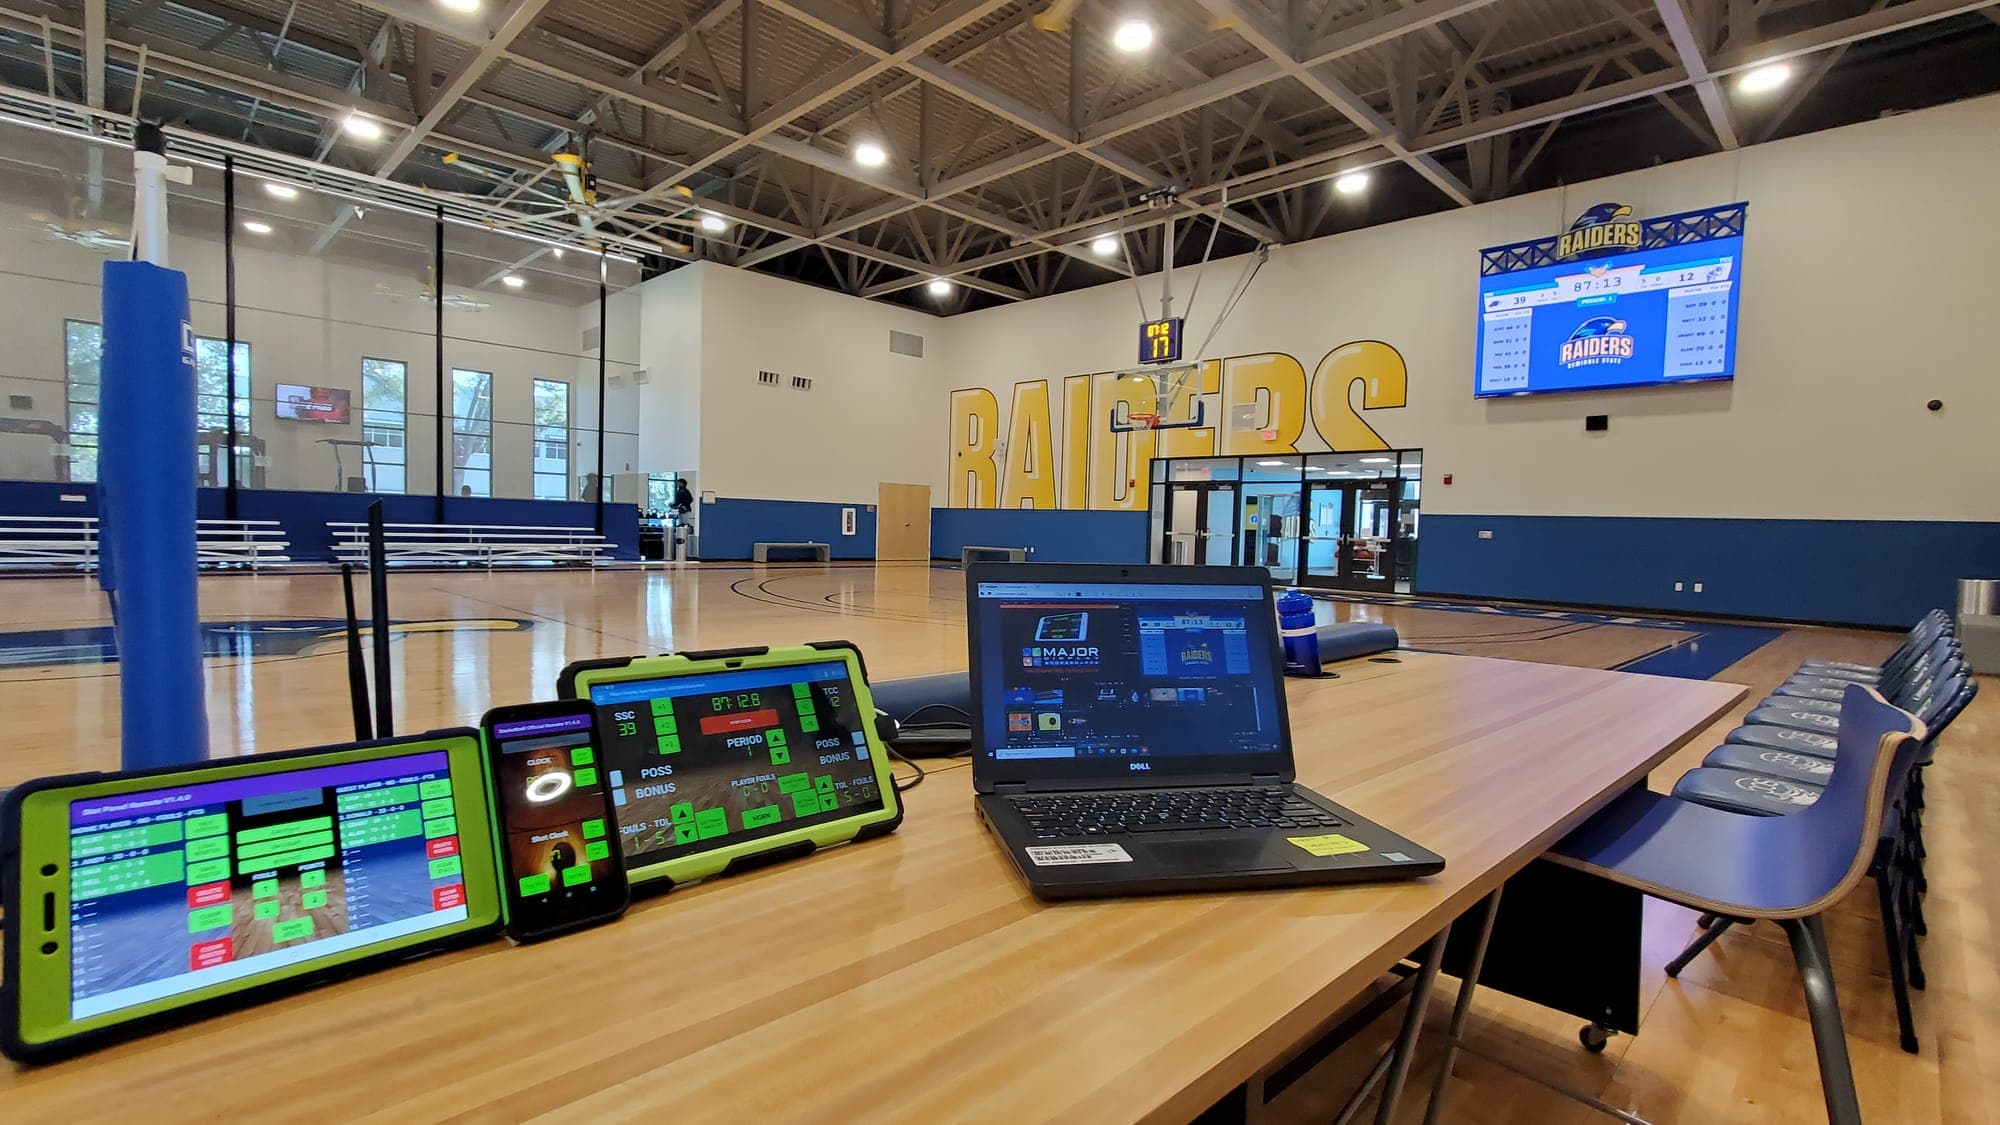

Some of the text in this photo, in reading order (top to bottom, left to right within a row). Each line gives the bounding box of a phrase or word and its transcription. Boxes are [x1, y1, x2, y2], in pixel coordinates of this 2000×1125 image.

[1559, 223, 1640, 257] RAIDERS
[1679, 272, 1694, 281] 12
[1574, 276, 1622, 292] 87:13
[1513, 296, 1526, 305] 39
[1153, 336, 1169, 358] 17
[1562, 336, 1631, 363] RAIDERS
[947, 340, 1408, 511] RAIDERS
[1043, 647, 1099, 657] MAJOR
[1181, 649, 1213, 662] RAIDERS
[824, 687, 839, 695] TCC
[711, 693, 760, 711] 87:12.8
[831, 696, 840, 708] 12
[614, 711, 636, 721] SSC
[618, 722, 637, 736] 39
[726, 734, 763, 748] PERIOD
[815, 738, 840, 749] POSS
[526, 757, 552, 766] CLOCK
[819, 752, 850, 765] BONUS
[641, 765, 673, 779] POSS
[1130, 762, 1151, 770] DELL
[731, 777, 756, 787] PLAYER
[756, 773, 776, 782] FOULS
[834, 781, 848, 790] TOL
[852, 776, 874, 786] FOULS
[635, 783, 677, 799] BONUS
[654, 818, 672, 828] TOL
[753, 813, 771, 822] HORN
[531, 831, 569, 843] Shot Clock
